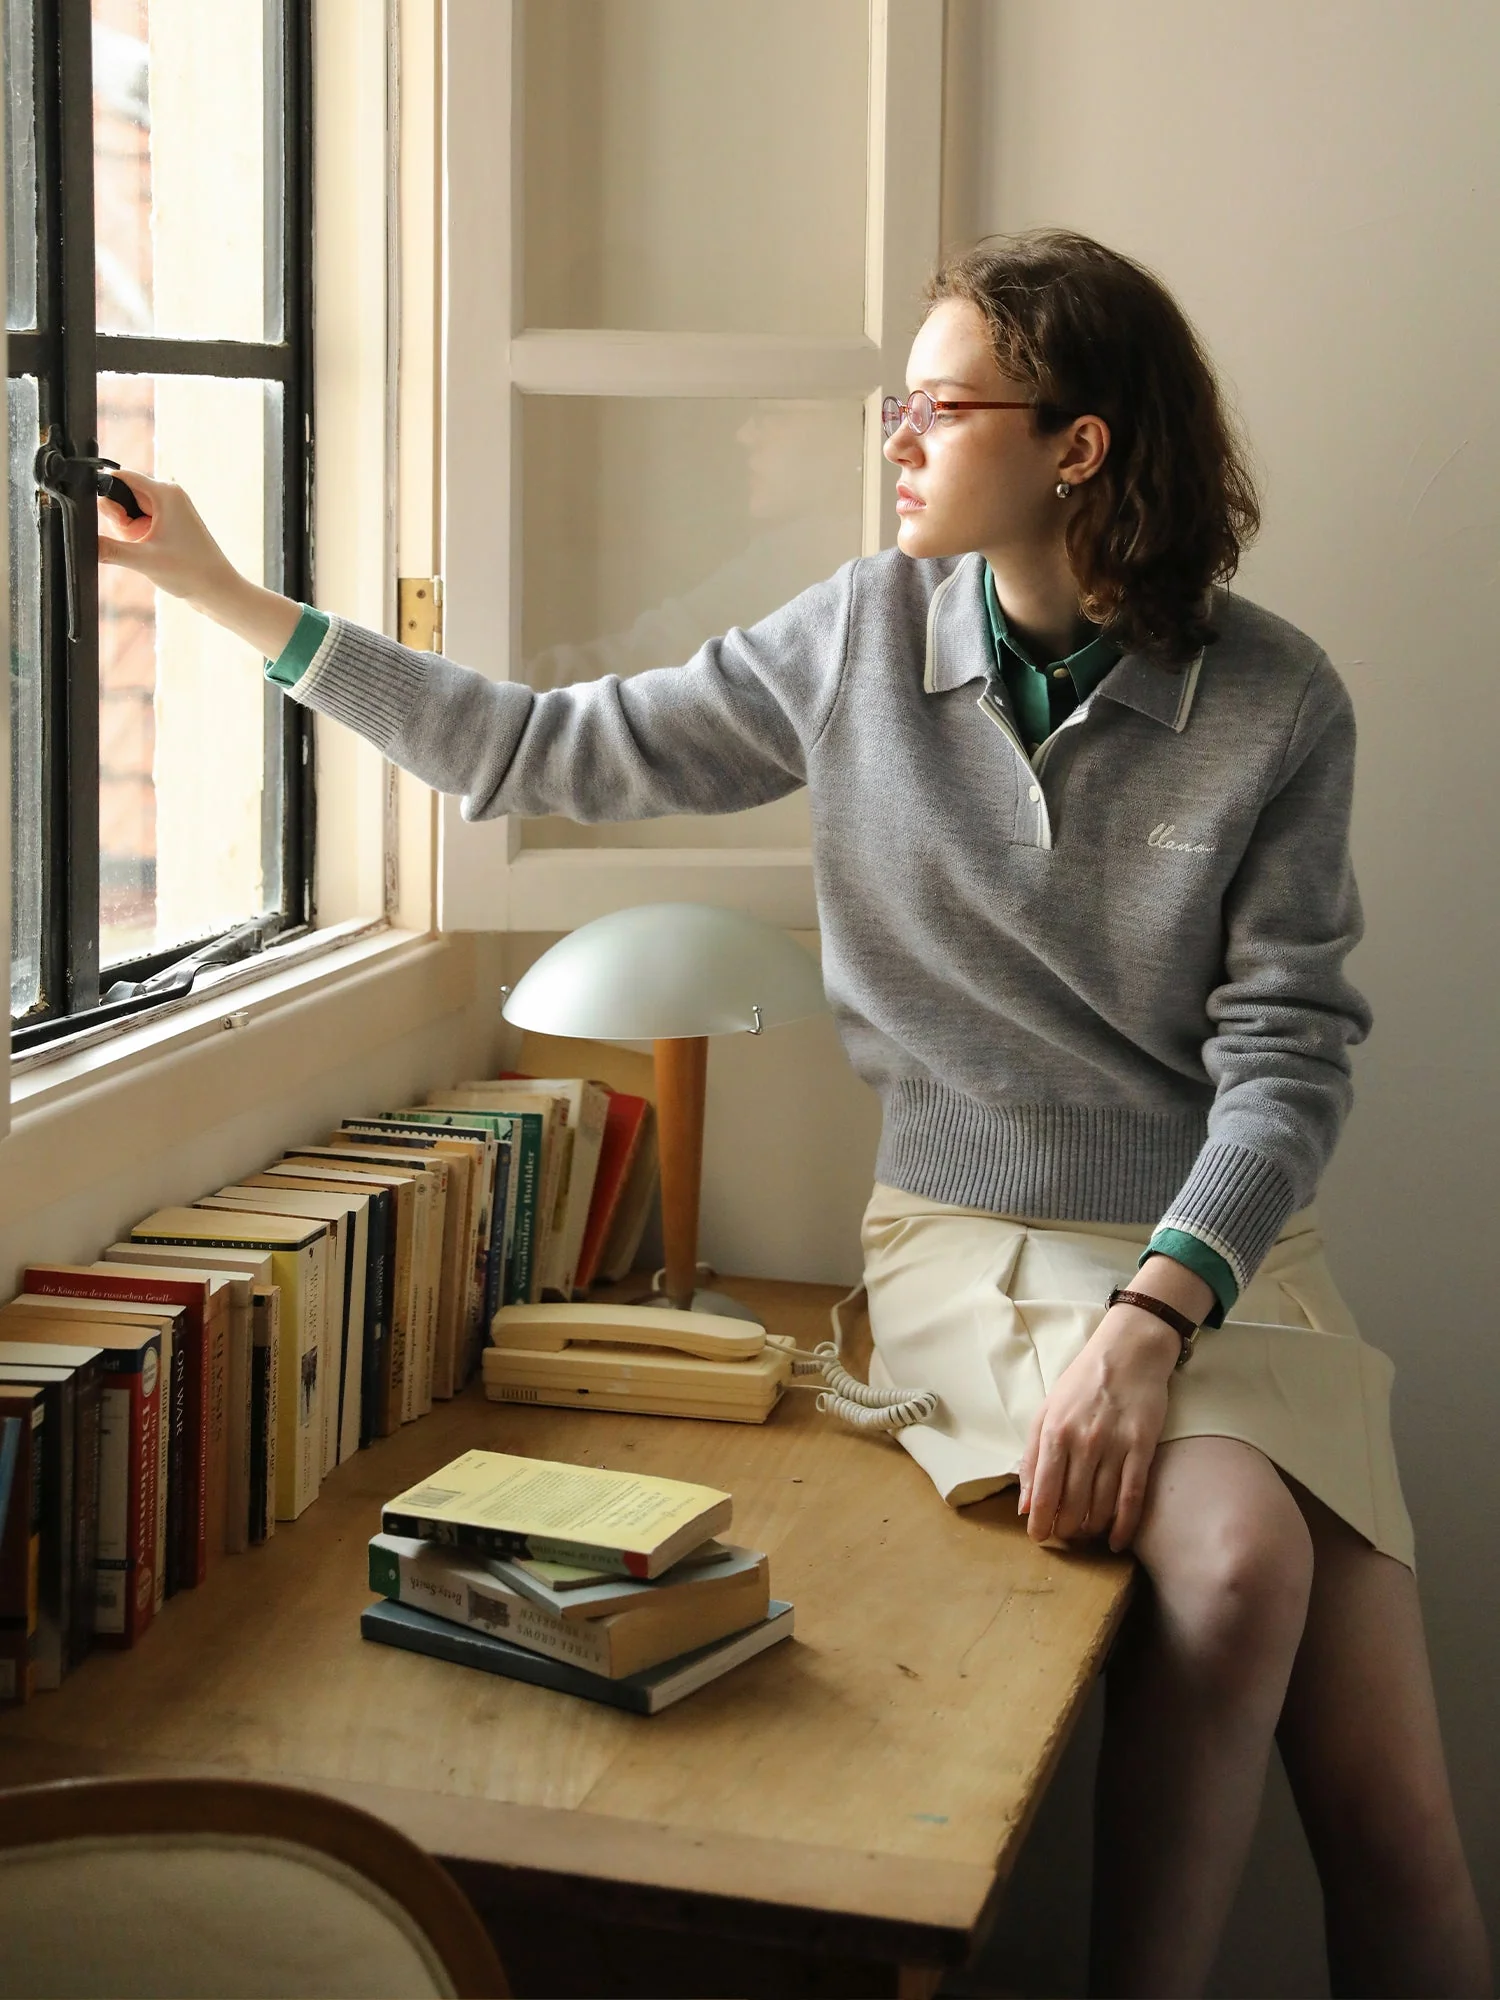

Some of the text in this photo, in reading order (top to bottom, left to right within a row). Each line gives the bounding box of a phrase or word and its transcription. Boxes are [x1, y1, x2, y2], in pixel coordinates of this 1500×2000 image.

[524, 1151, 535, 1203] Builder
[211, 1240, 273, 1250] CLASSIC
[518, 1209, 532, 1290] Vocabulary
[89, 1288, 102, 1298] des
[176, 1349, 185, 1436] ON WAR
[138, 1402, 151, 1565] Dictionary
[409, 1575, 463, 1607] Betty Smith
[515, 1624, 557, 1647] GROWS
[518, 1607, 580, 1640] BROOKLYN
[560, 1640, 590, 1660] TREE
